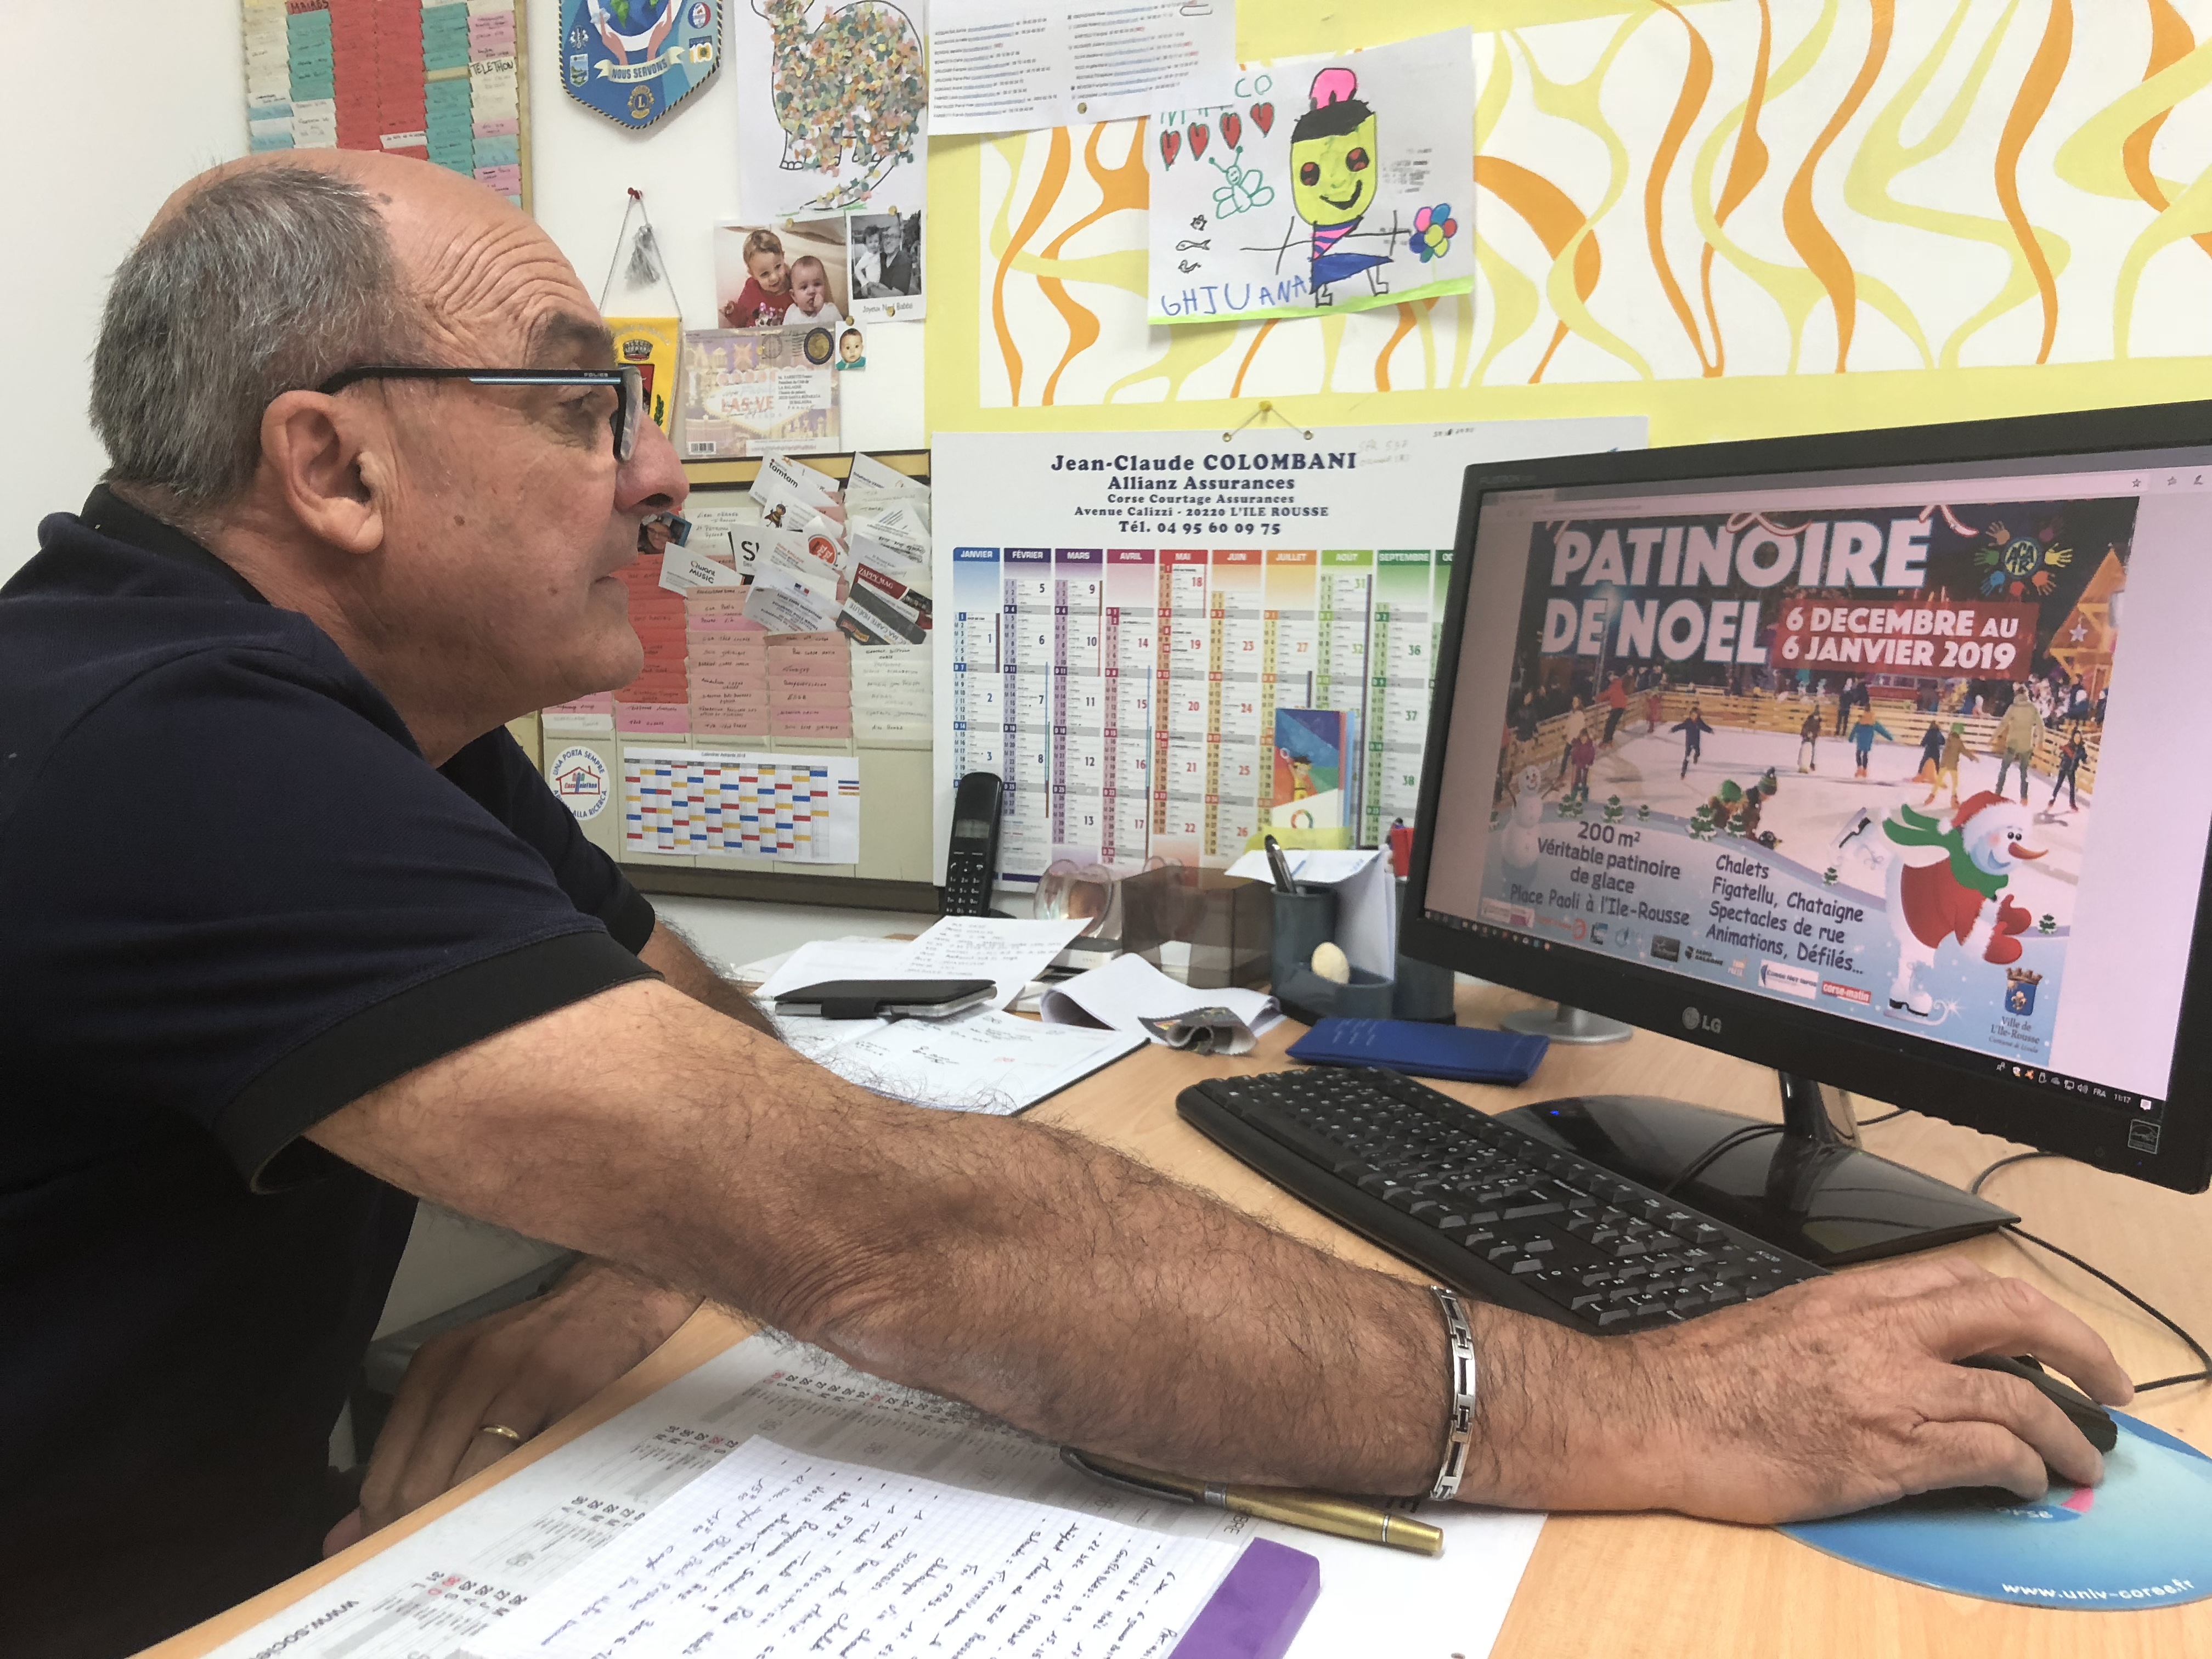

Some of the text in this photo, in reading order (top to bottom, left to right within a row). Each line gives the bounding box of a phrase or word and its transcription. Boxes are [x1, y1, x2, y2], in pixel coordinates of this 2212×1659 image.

[470, 59, 514, 76] TELETHON
[612, 58, 668, 80] NOUS SERVONS
[1051, 455, 1194, 472] Jean-Claude
[1204, 453, 1357, 471] COLOMBANI
[769, 462, 798, 488] tamtam
[1108, 477, 1295, 490] Allianz Assurances
[1108, 494, 1295, 505] Corse Courtage Assurances
[1075, 507, 1329, 517] Avenue Calizzi 20220 L'ILE ROUSSE
[1119, 521, 1281, 535] Tél. 04 95 60 09 75
[1012, 550, 1043, 558] FÉVRIER
[1379, 553, 1429, 561] SEPTEMBRE
[1551, 517, 1933, 588] PATINOIRE
[689, 568, 715, 584] MUSIC
[879, 578, 893, 589] MAG
[1192, 577, 1203, 587] 18
[1039, 584, 1045, 593] 5
[1090, 585, 1095, 594] 9
[1785, 607, 2019, 639] 6 DECEMBRE AU
[1542, 598, 1769, 665] DE NOEL
[988, 634, 991, 643] 1
[1039, 635, 1045, 645] 6
[1087, 637, 1097, 646] 10
[1138, 639, 1149, 648] 14
[1190, 640, 1200, 650] 19
[1297, 642, 1308, 652] 27
[1408, 645, 1421, 655] 36
[1781, 637, 2017, 670] 6 JANVIER 2019
[988, 693, 992, 702] 2
[1039, 695, 1043, 704] 7
[1086, 697, 1094, 707] 11
[1137, 699, 1147, 709] 15
[1188, 701, 1200, 711] 20
[1241, 704, 1252, 713] 24
[1406, 710, 1417, 721] 37
[987, 752, 992, 761] 3
[1038, 754, 1043, 764] 8
[1086, 757, 1095, 766] 12
[552, 749, 605, 776] UNA PORTA SEMPRE
[1136, 759, 1146, 769] 16
[1187, 763, 1197, 772] 21
[1239, 765, 1250, 775] 25
[1402, 775, 1415, 786] 38
[589, 790, 607, 816] RICERCA
[1084, 816, 1093, 825] 13
[1135, 819, 1144, 829] 17
[1185, 823, 1196, 833] 22
[1237, 827, 1248, 837] 26
[1578, 821, 1615, 844] 200
[1538, 838, 1680, 881] Véritable patinoire
[1716, 854, 1770, 879] Chalets
[1570, 866, 1635, 894] de glace
[1510, 884, 1690, 926] Place Paoli à l'Ile-Rousse
[1712, 876, 1864, 924] Figatellu, Chataigne
[1709, 900, 1845, 944] Spectacles de rue
[1706, 924, 1788, 960] Animations,
[1823, 983, 1870, 1002] corse-matin
[1702, 1015, 1722, 1035] LG
[2001, 1017, 2020, 1030] Ville
[2093, 1087, 2106, 1098] FRA
[2002, 1577, 2194, 1600] www.univ-corse.fr
